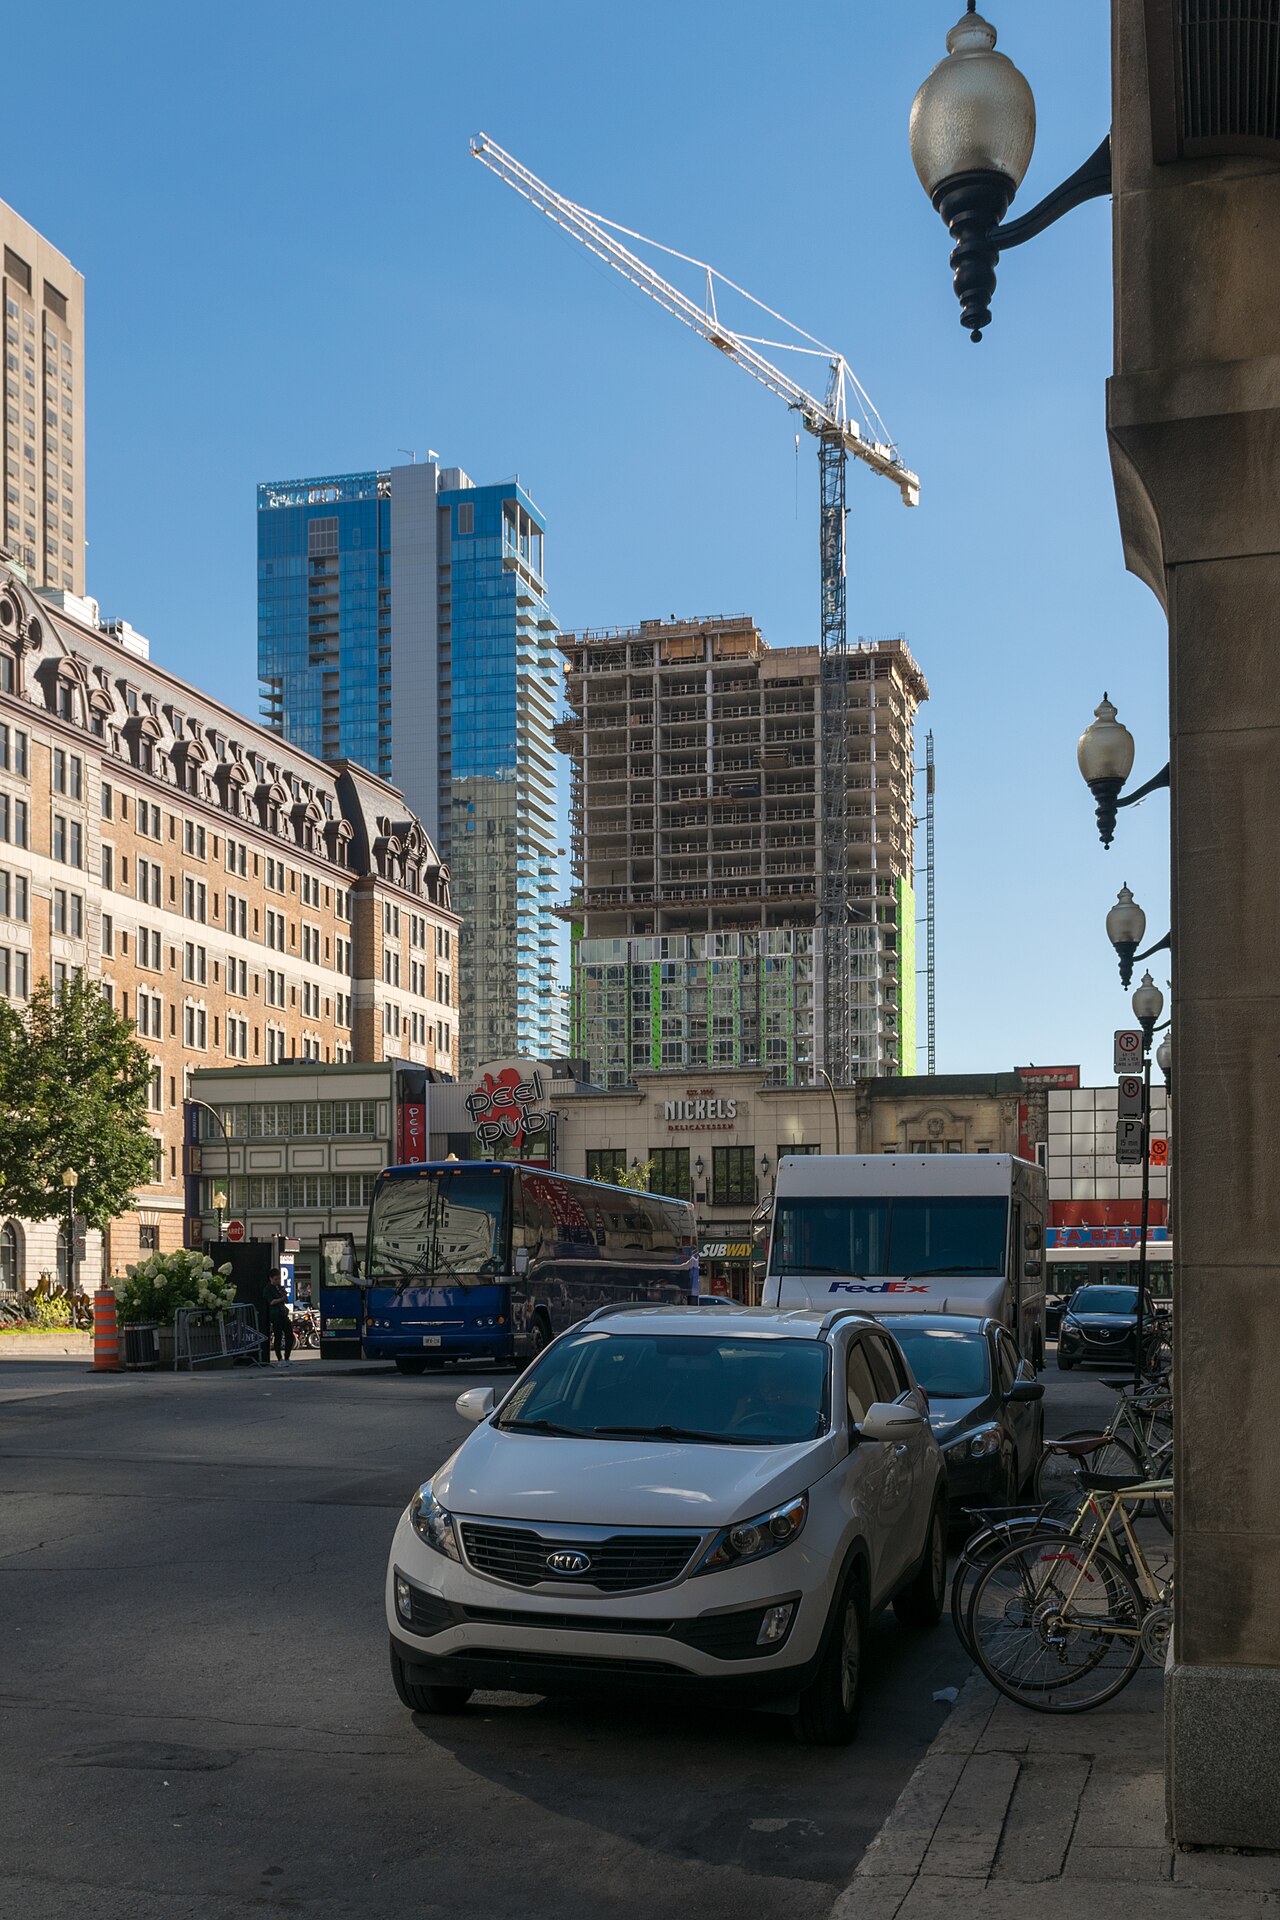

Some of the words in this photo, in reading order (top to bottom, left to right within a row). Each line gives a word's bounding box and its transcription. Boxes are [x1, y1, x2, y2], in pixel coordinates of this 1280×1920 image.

[664, 1099, 737, 1120] NICKELS
[667, 1123, 734, 1132] DELICATESSEN
[1056, 1229, 1082, 1241] LA
[1091, 1229, 1155, 1241] BELLE
[699, 1243, 754, 1257] SUBWAY
[828, 1281, 931, 1294] FedEx
[553, 1555, 584, 1569] KIA
